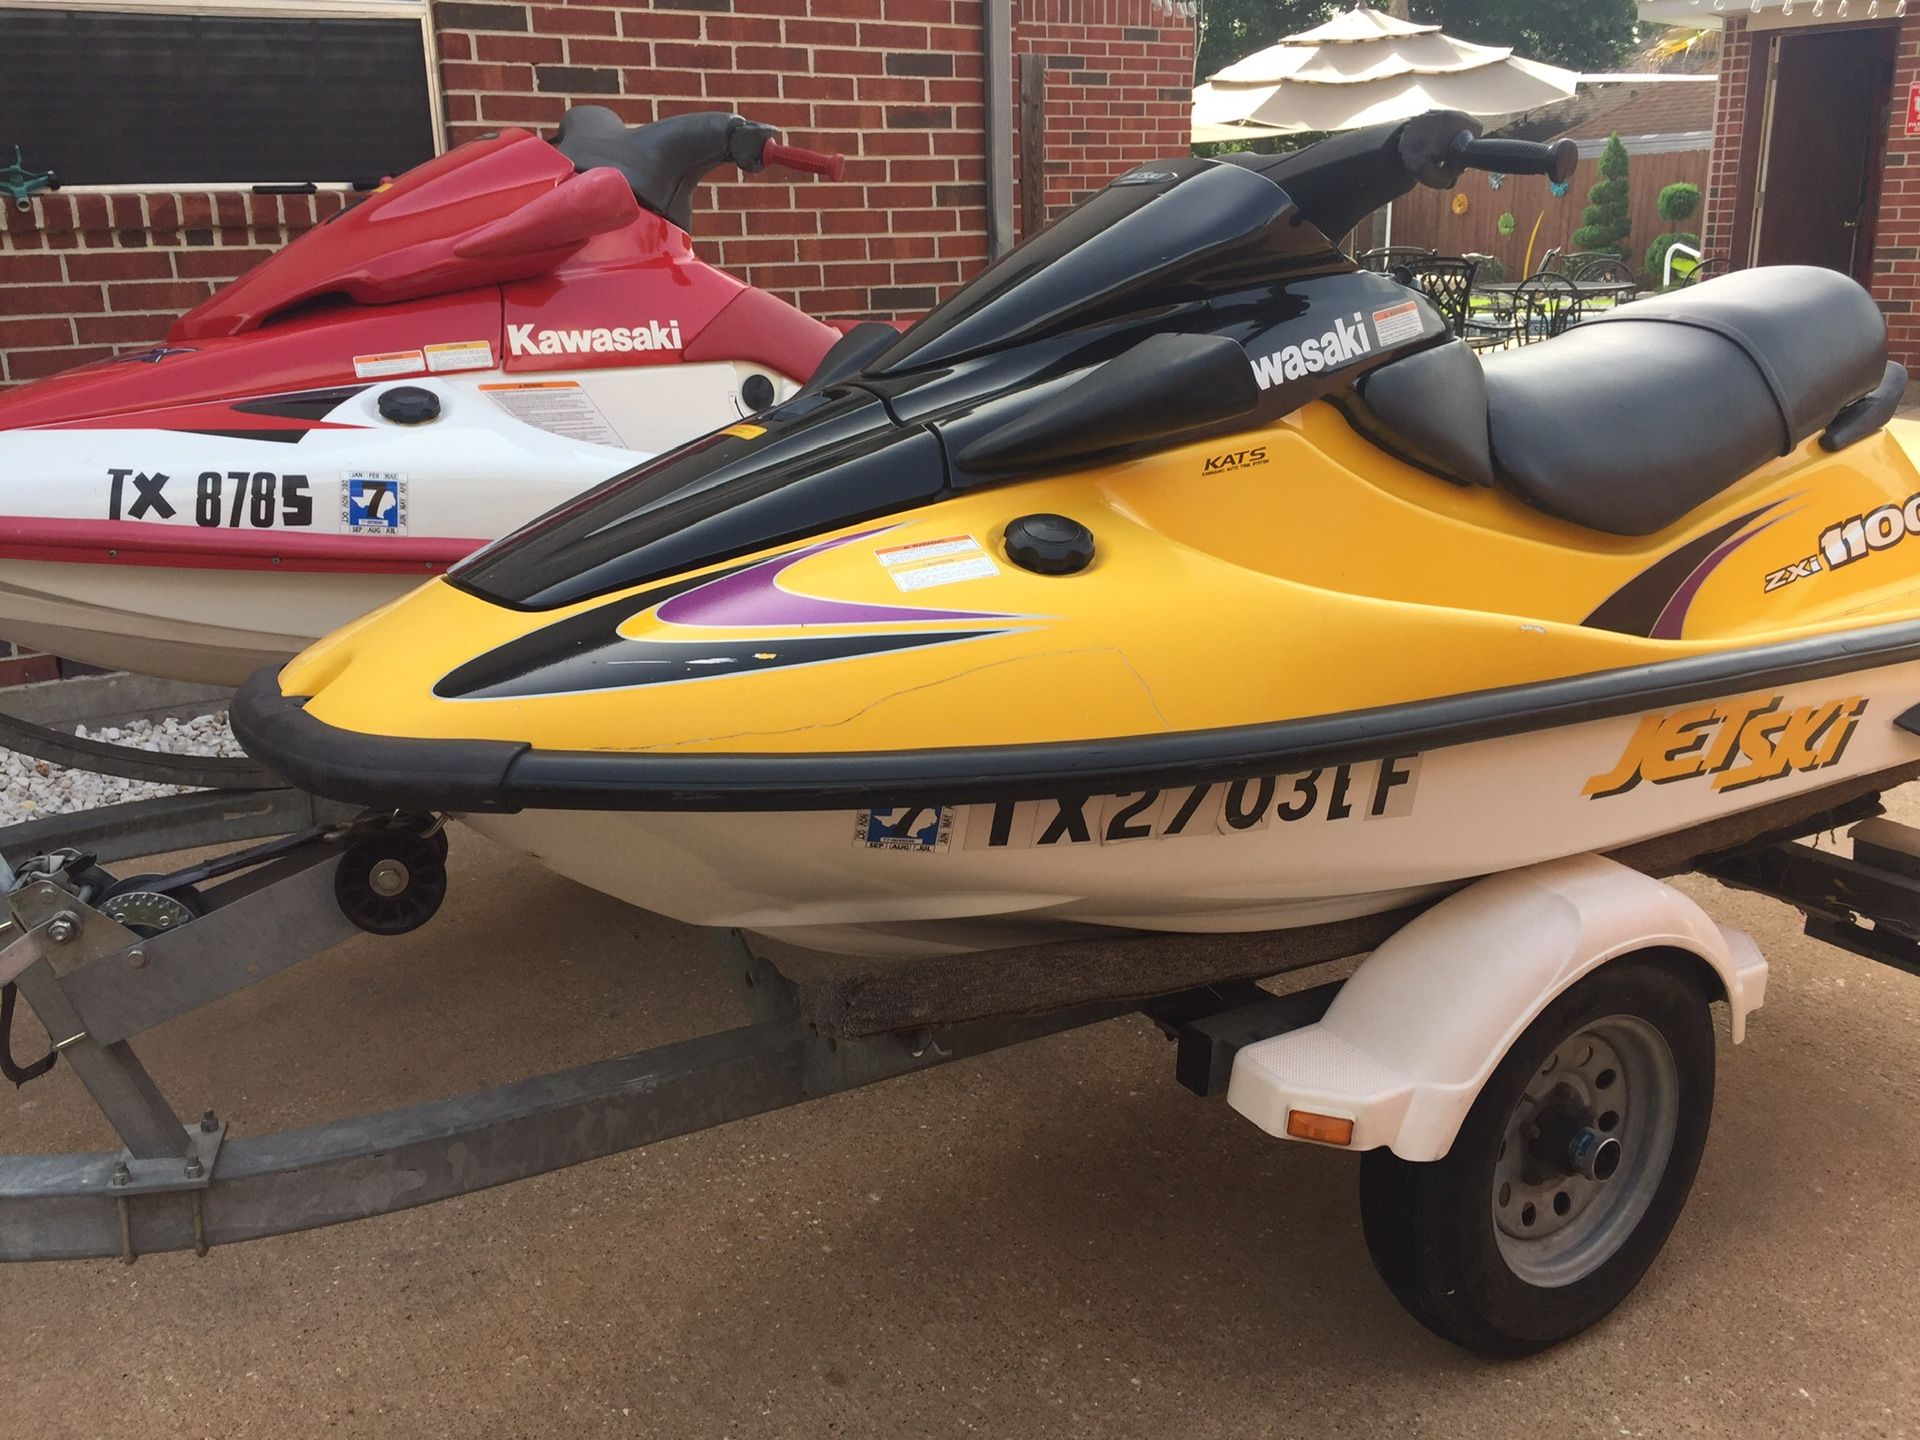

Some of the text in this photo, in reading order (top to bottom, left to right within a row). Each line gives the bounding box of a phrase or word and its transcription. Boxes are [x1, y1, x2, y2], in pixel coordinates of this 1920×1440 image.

[507, 320, 682, 356] Kawasaki
[1204, 446, 1267, 471] KATS
[107, 468, 312, 528] TX 8785
[362, 480, 387, 519] 7
[891, 843, 910, 851] AUG
